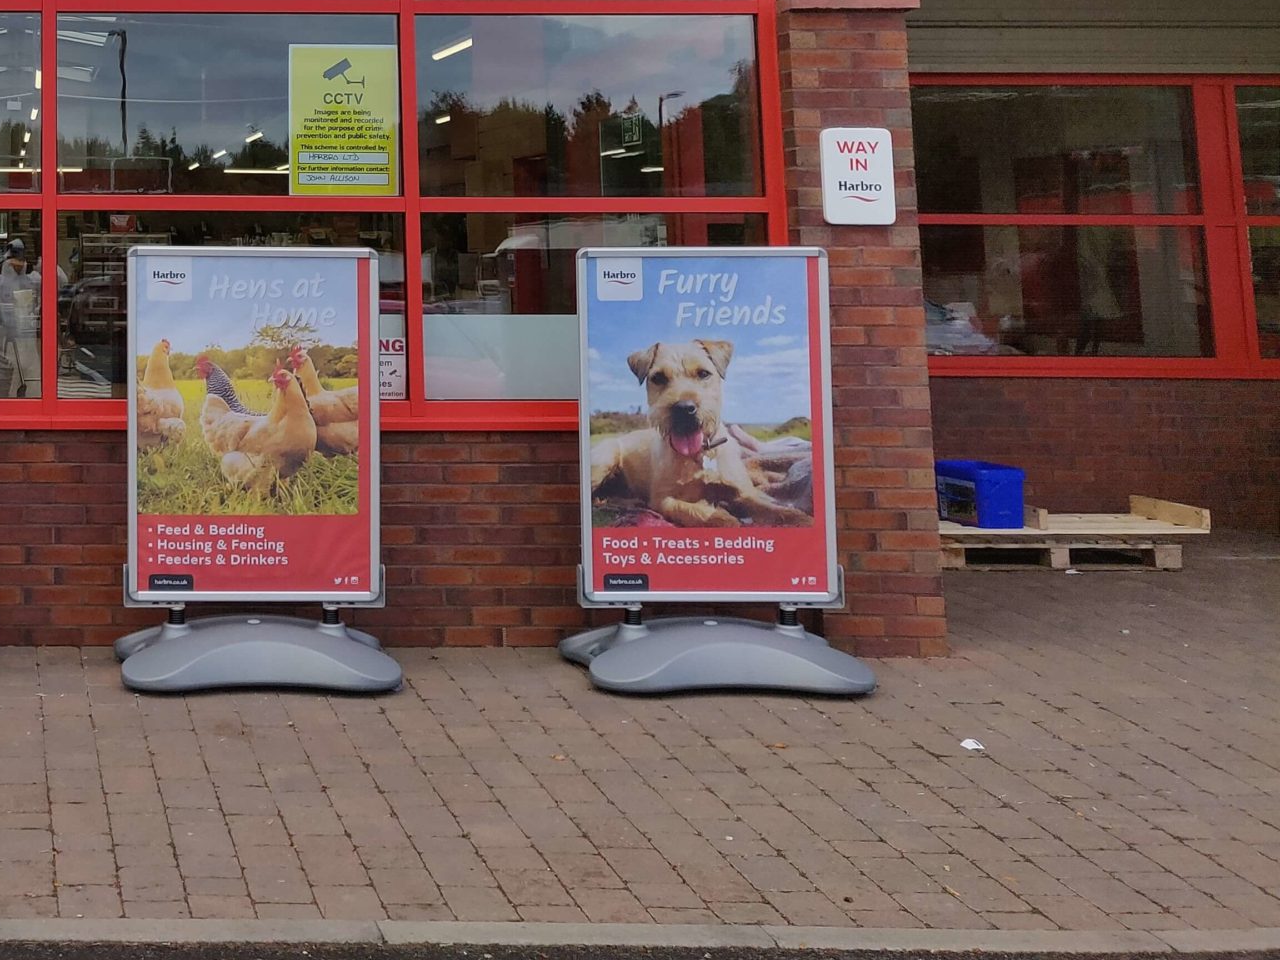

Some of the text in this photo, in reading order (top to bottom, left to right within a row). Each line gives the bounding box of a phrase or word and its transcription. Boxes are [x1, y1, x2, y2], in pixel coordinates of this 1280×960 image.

[323, 92, 363, 104] CCTV
[836, 141, 879, 154] WAY
[849, 158, 868, 171] IN
[838, 181, 882, 192] Harbro
[153, 270, 186, 280] Harbro
[603, 270, 636, 280] Harbro
[209, 274, 327, 300] Hens at
[658, 269, 739, 302] Furry
[251, 302, 336, 328] Home
[675, 295, 786, 328] Friends
[157, 524, 265, 538] Feed & Bedding
[157, 539, 284, 553] Housing & Fencing
[602, 537, 775, 552] Food Treats Bedding
[157, 554, 288, 565] Feeders & Drinkers
[603, 553, 745, 567] Toys & Accessories
